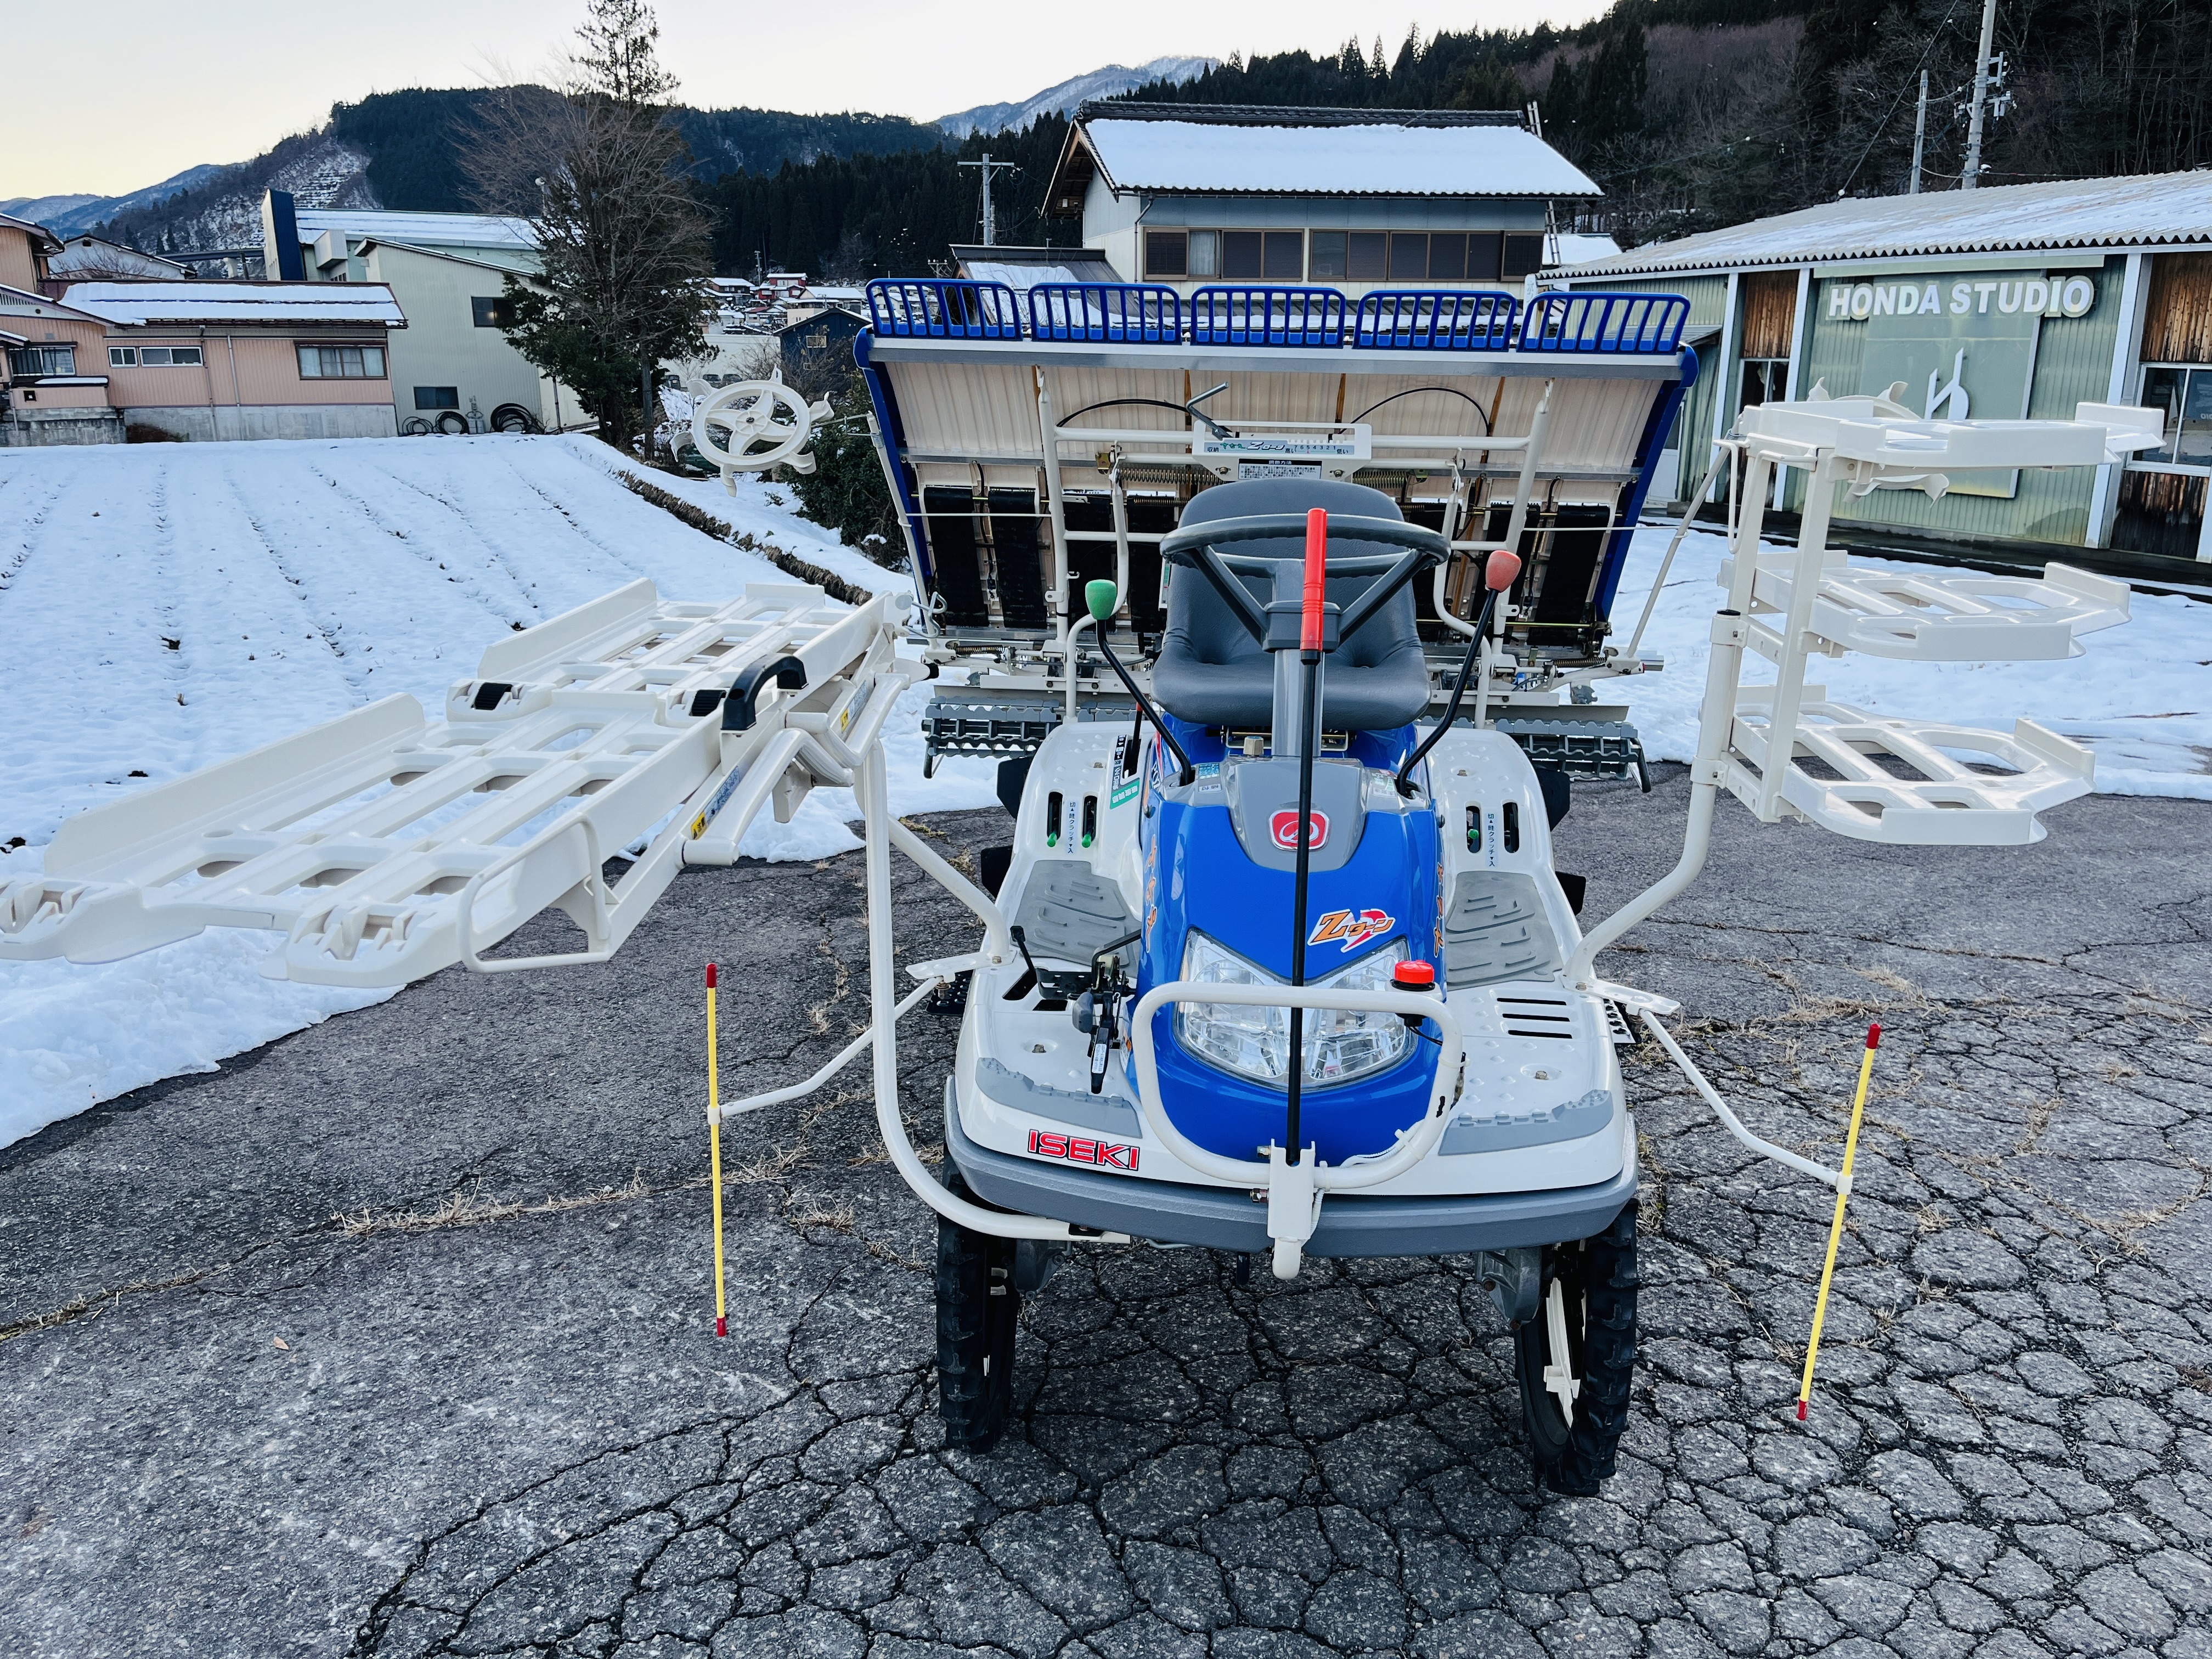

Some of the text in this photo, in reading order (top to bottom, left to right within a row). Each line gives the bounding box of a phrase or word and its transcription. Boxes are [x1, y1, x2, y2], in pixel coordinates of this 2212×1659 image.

[1829, 279, 2091, 317] HONDA STUDIO
[1310, 911, 1394, 944] Zターン
[1028, 1129, 1140, 1171] ISEKI
